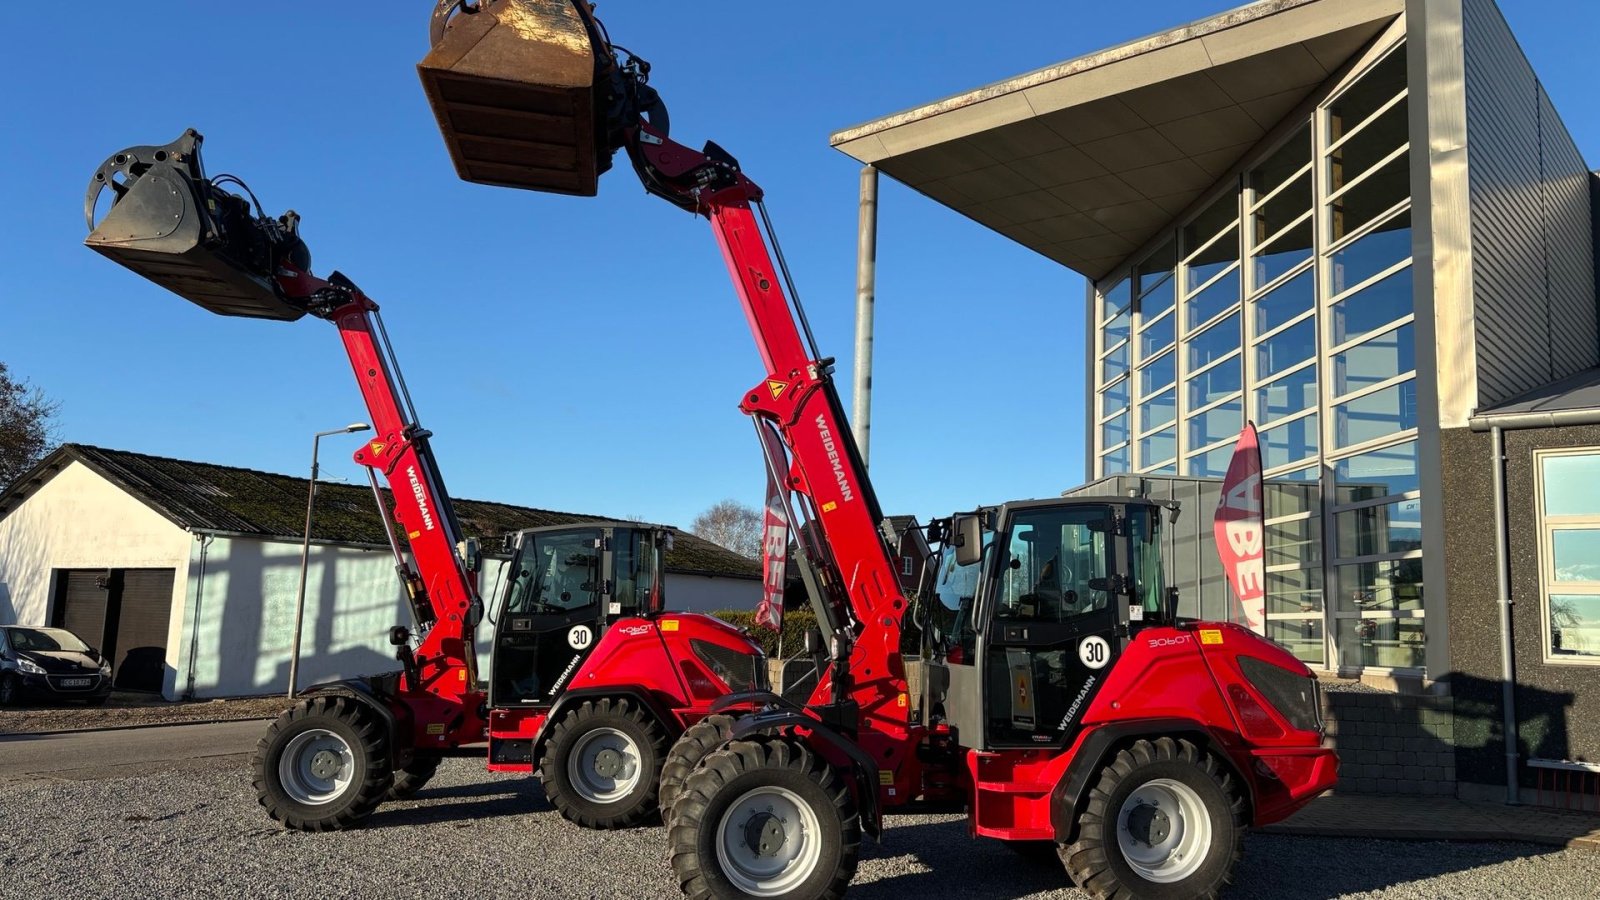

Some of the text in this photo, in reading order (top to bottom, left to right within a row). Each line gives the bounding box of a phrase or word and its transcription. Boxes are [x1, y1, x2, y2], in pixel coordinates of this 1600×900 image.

[815, 414, 853, 502] WEIDEMANN
[406, 465, 435, 531] WEIDEMANN
[573, 629, 587, 645] 30
[1085, 642, 1104, 663] 30
[1148, 634, 1192, 648] 3060T
[548, 654, 581, 696] WEIDEMANN
[1057, 675, 1096, 732] WEIDEMANN
